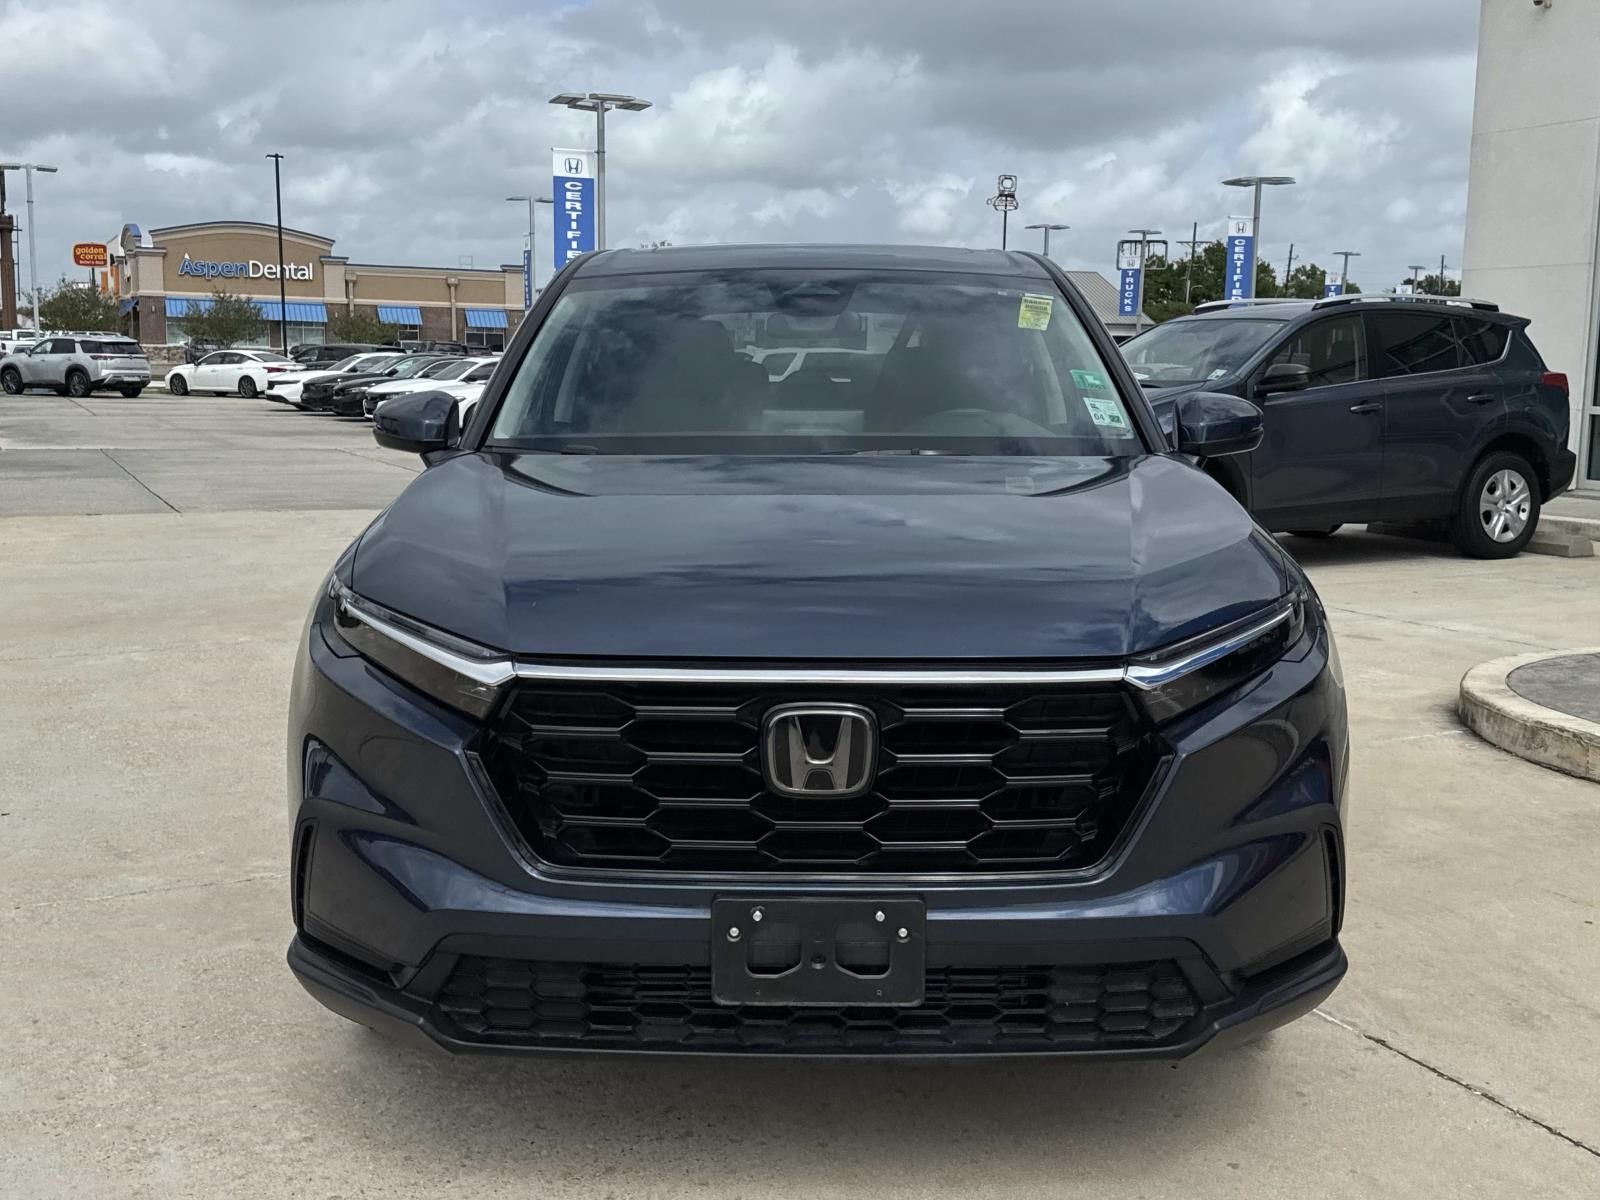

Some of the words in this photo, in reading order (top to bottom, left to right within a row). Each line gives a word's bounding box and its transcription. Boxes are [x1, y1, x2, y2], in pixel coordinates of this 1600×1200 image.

[564, 181, 583, 263] CERTIFIE
[75, 246, 105, 255] golden
[80, 252, 107, 260] corral
[1124, 270, 1134, 312] TRUCKS
